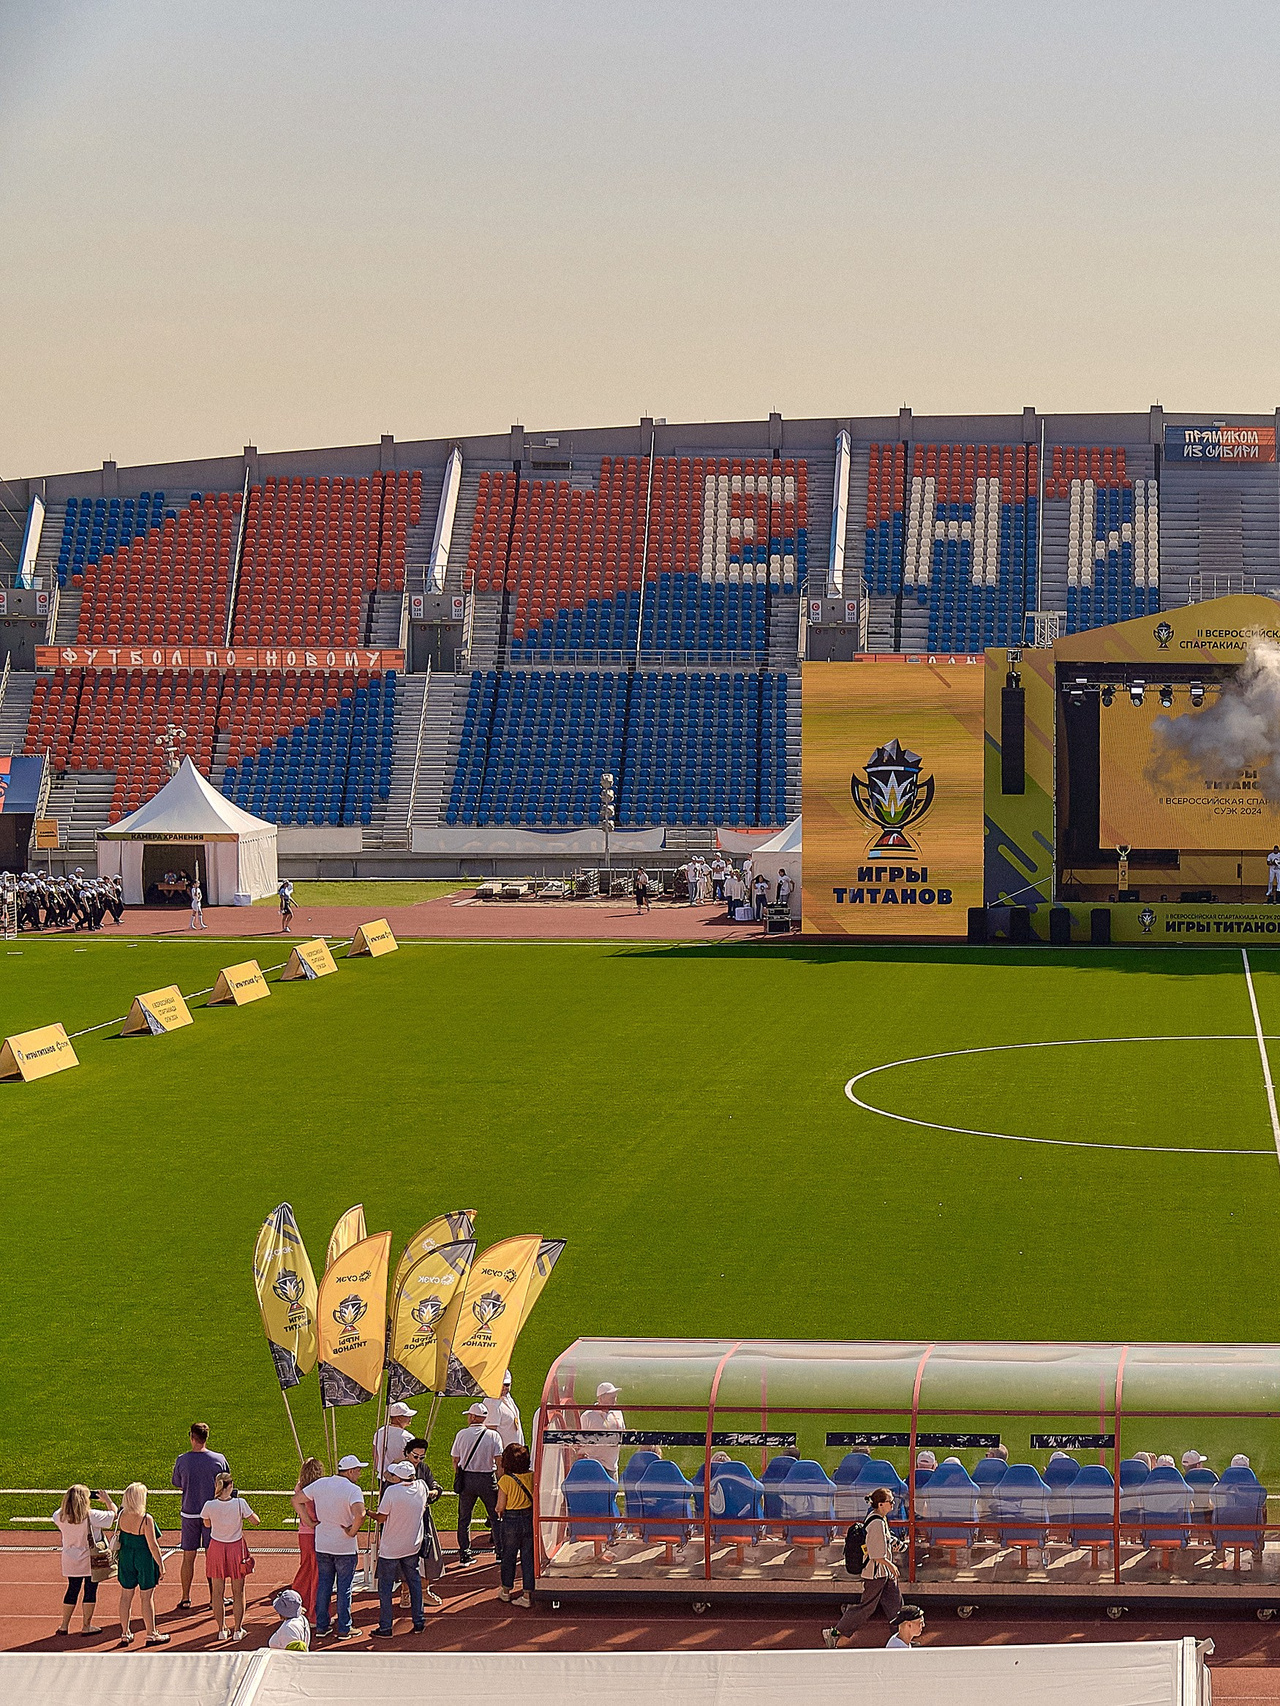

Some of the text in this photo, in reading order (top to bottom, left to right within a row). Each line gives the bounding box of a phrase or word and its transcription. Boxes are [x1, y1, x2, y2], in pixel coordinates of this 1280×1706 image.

[1184, 429, 1259, 444] ПРЯМИКОМ
[1183, 445, 1259, 458] ИЗ СИБИРИ
[1196, 629, 1204, 638] II
[1179, 640, 1250, 650] СПАРТАКИАД
[61, 648, 381, 667] ФУТБОЛ ПО-НОВОМУ
[1204, 780, 1261, 791] ТИТАНО
[1165, 796, 1244, 806] ВСЕРОССИЙСКАЯ
[1213, 807, 1262, 815] СУЭК 2024
[131, 833, 163, 841] КАМЕРА
[857, 866, 928, 883] ИГРЫ
[832, 887, 953, 905] ТИТАНОВ
[1165, 921, 1211, 933] ИГРЫ
